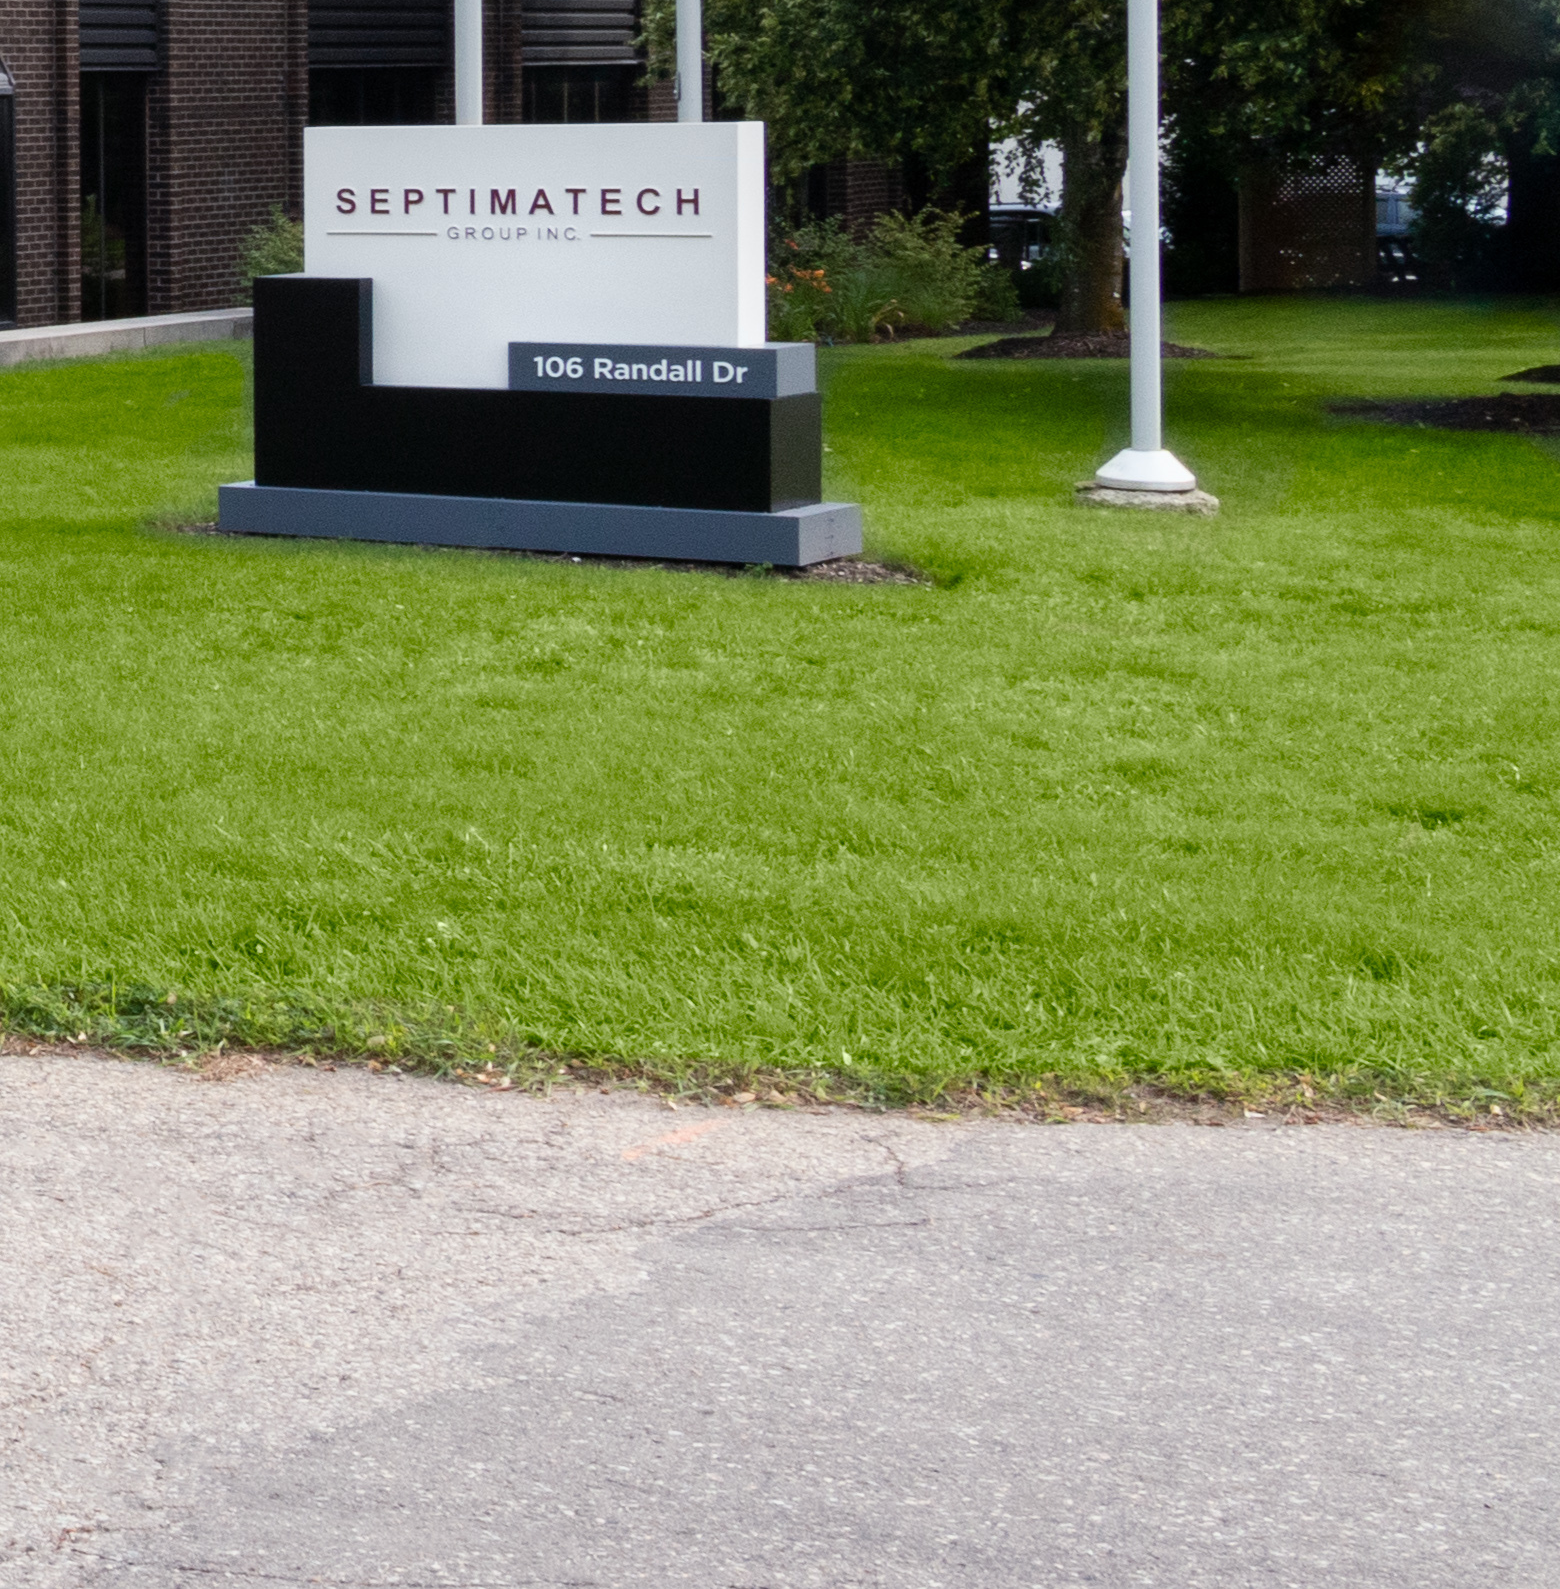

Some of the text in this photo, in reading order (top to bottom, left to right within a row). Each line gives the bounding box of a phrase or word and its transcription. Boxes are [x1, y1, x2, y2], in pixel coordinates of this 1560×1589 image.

[335, 188, 700, 216] SEPTIMATECH
[446, 226, 582, 241] GROUP INC.
[533, 356, 749, 384] 106 Randall Dr
